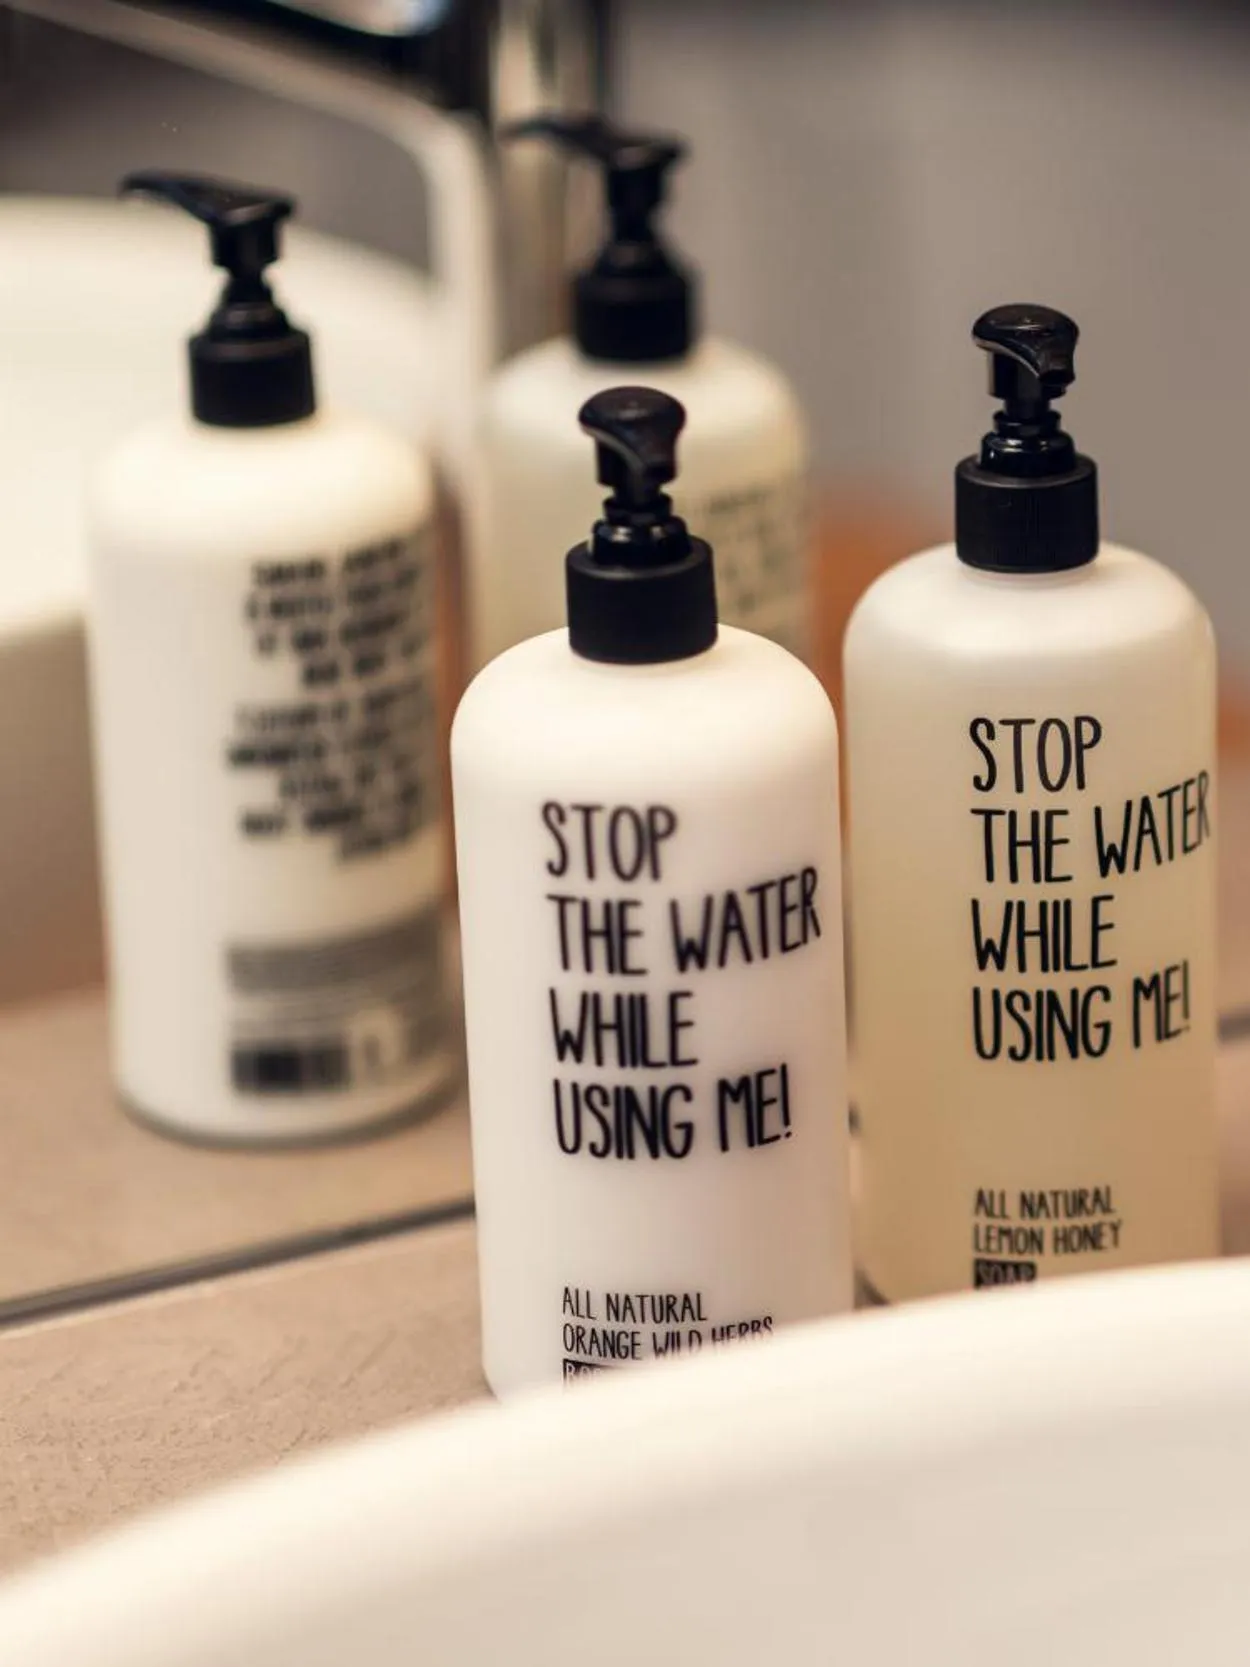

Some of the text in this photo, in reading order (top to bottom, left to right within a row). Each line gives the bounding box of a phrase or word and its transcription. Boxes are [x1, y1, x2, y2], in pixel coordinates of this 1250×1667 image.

[968, 714, 1103, 794] STOP
[541, 800, 679, 883] STOP
[969, 769, 1211, 885] THE WATER
[546, 893, 649, 977] THE
[669, 865, 823, 975] WATER
[970, 894, 1118, 974] WHILE
[548, 986, 700, 1070] WHILE
[972, 960, 1190, 1063] USING ME!
[552, 1061, 794, 1161] USING ME!
[973, 1219, 1123, 1256] LEMON HONEY
[974, 1185, 1115, 1220] ALL NATURAL
[562, 1286, 709, 1325] ALL NATURAL
[562, 1322, 643, 1361] ORANGE
